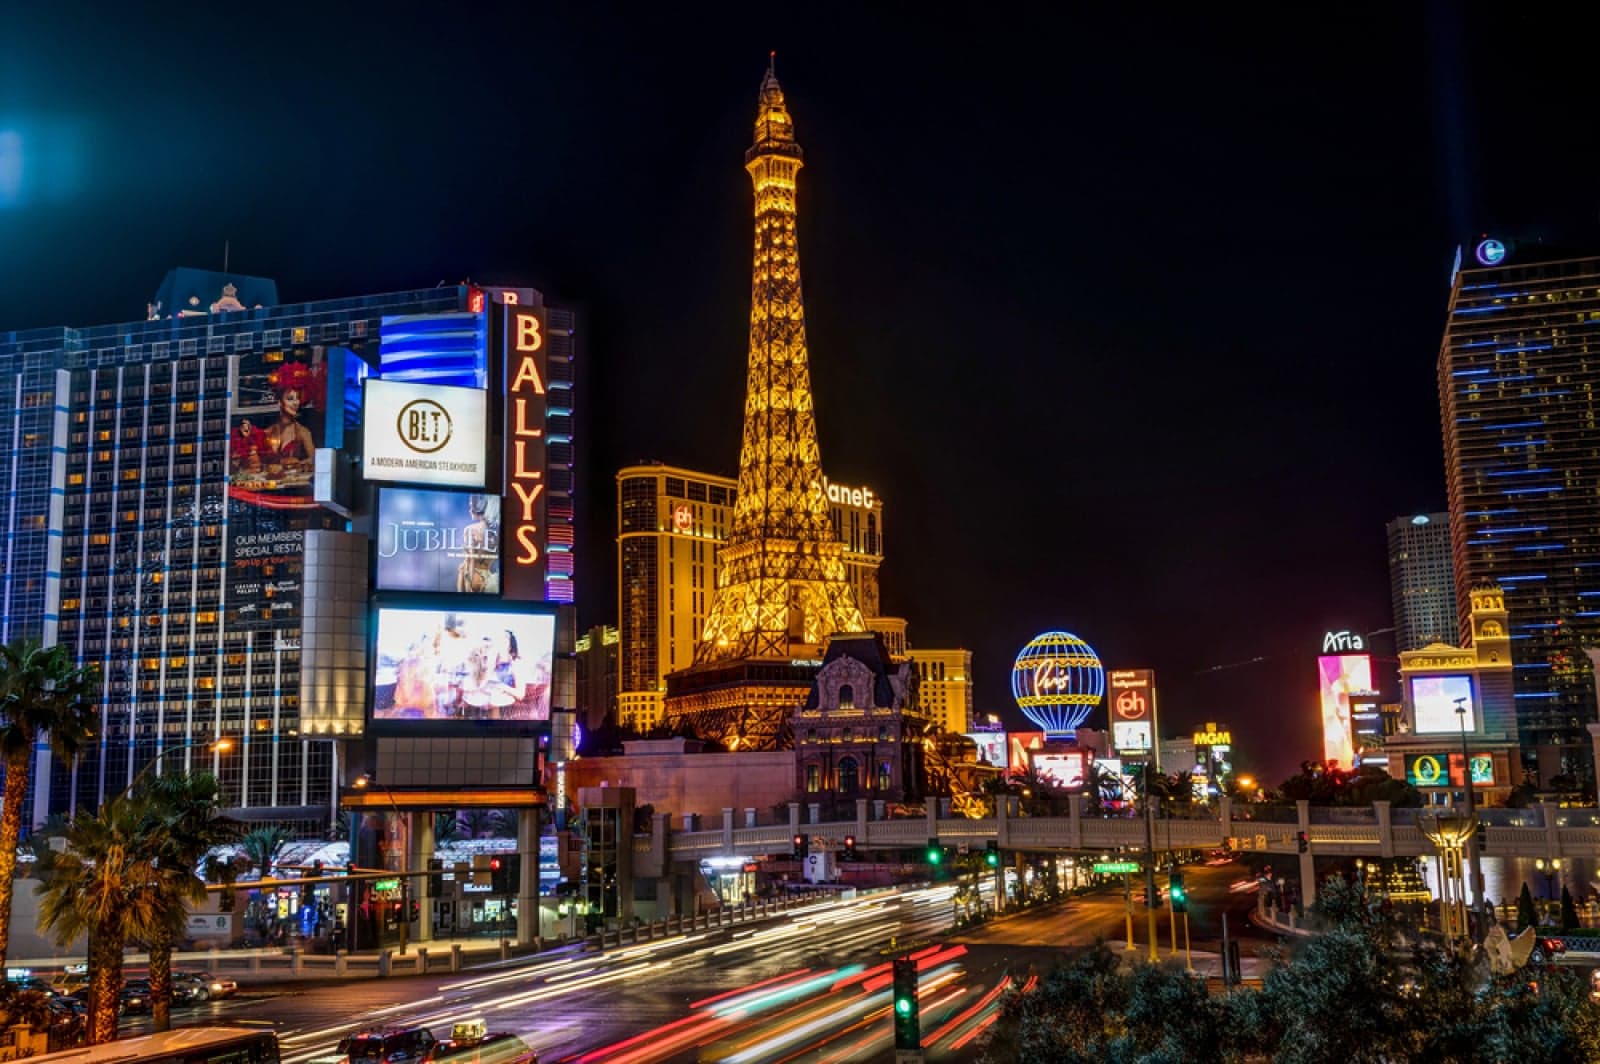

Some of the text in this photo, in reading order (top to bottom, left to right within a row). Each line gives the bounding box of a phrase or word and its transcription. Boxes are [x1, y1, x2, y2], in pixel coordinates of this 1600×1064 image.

[409, 410, 441, 442] BLT
[511, 314, 545, 566] BALLYS
[376, 457, 404, 468] MODERN
[405, 459, 437, 470] AMERICAN
[438, 461, 478, 473] STEAKHOUSE
[235, 535, 256, 545] OUR
[234, 545, 272, 558] SPECIAL
[1322, 631, 1364, 653] Aria
[1034, 658, 1070, 701] Paris
[1194, 732, 1232, 745] MGM
